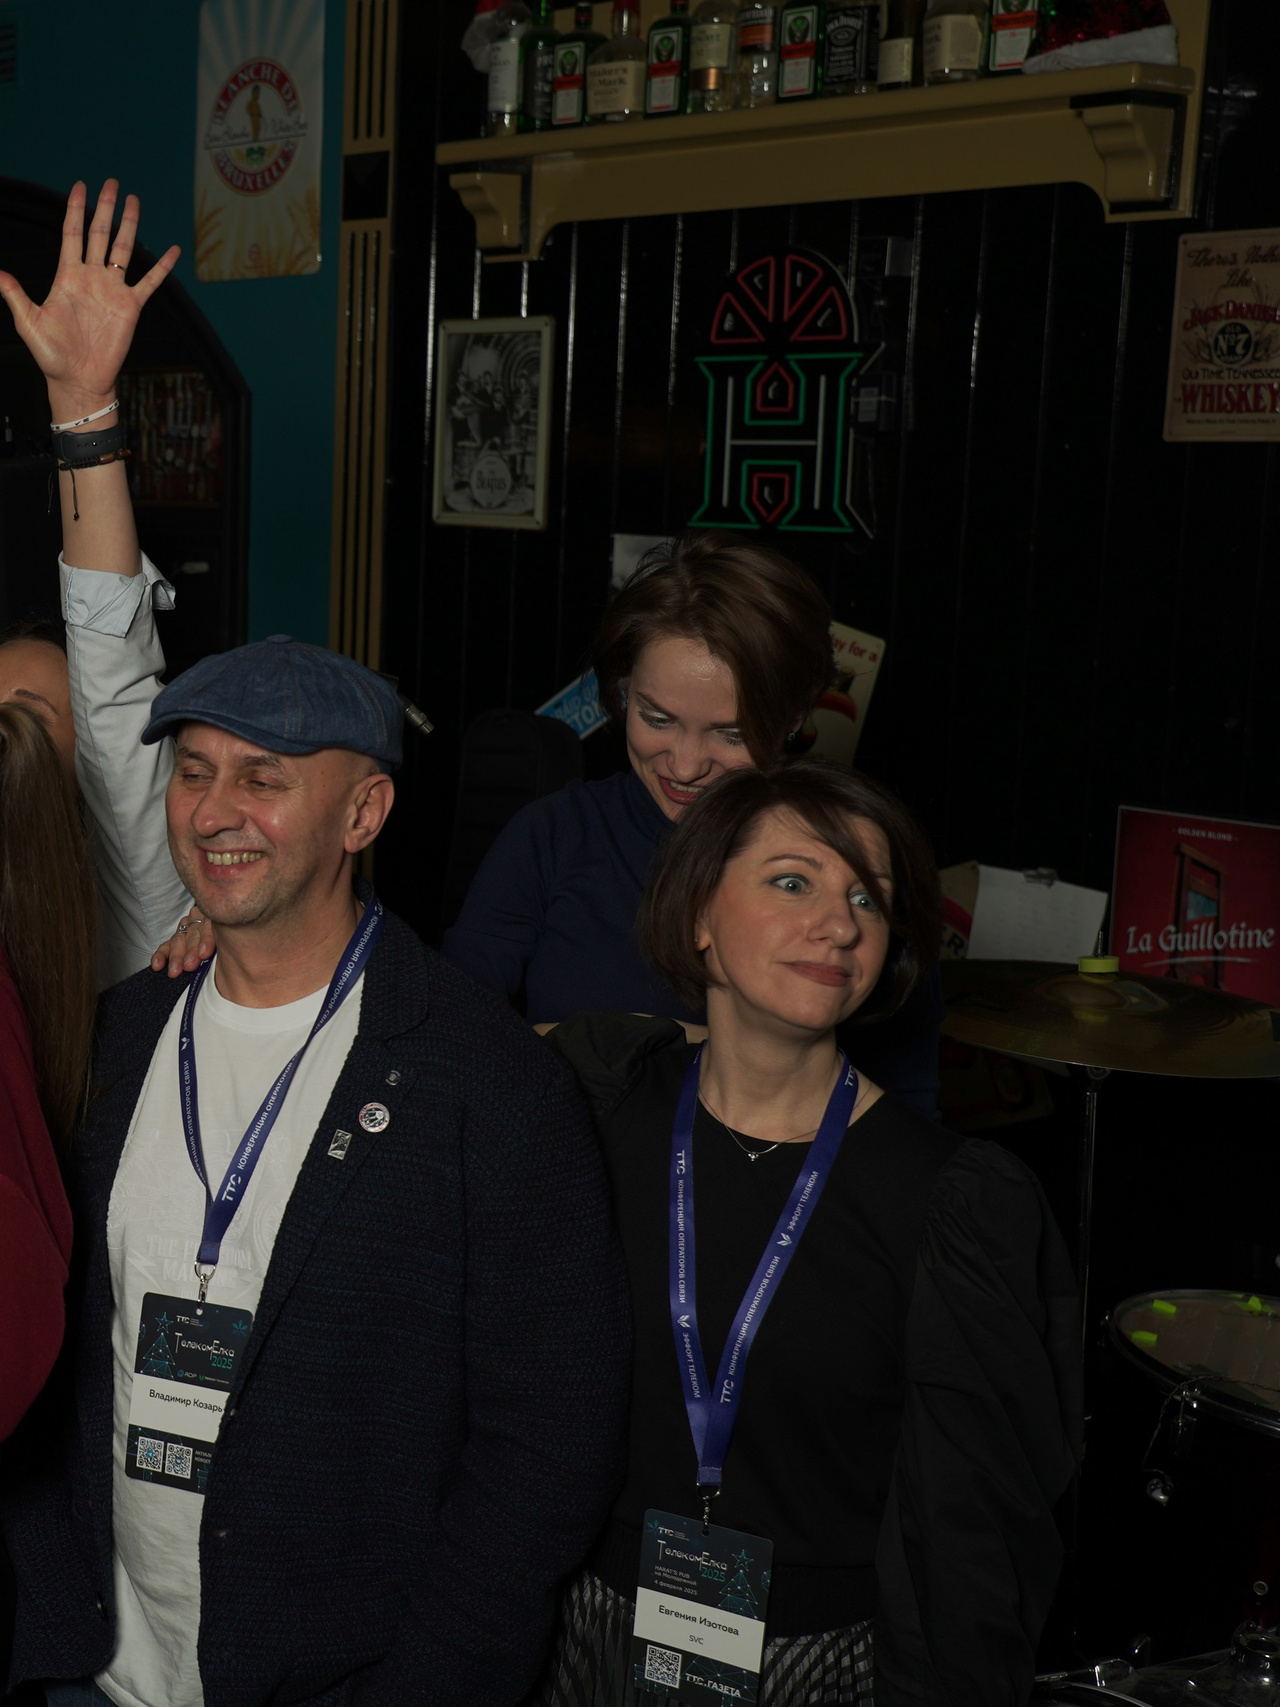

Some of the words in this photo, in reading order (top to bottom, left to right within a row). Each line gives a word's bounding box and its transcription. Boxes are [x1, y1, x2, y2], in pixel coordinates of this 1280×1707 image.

[1183, 304, 1224, 331] JACK
[1202, 368, 1224, 381] TIME
[1181, 382, 1280, 414] WHISKEY
[476, 469, 506, 493] BEATLES
[849, 641, 867, 659] for
[868, 652, 878, 663] a
[1177, 827, 1206, 838] GOLDEN
[1207, 831, 1233, 842] BLOND
[351, 915, 379, 962] КОНФЕРЕНЦИЯ
[1126, 925, 1153, 954] La
[1158, 922, 1276, 955] Guillotine
[328, 961, 355, 1009] ОПЕРАТОРОВ
[183, 1060, 191, 1085] СВЯЗИ
[185, 1086, 194, 1135] ОПЕРАТОРОВ
[237, 1111, 269, 1170] КОНФЕРЕНЦИЯ
[677, 1179, 685, 1232] КОНФЕРЕНЦИЯ
[678, 1232, 686, 1277] ОПЕРАТОРОВ
[728, 1322, 749, 1376] КОНФЕРЕНЦИЯ
[744, 1277, 769, 1322] ОПЕРАТОРОВ
[765, 1255, 780, 1278] СВЯЗИ
[787, 1202, 805, 1232] ЭФФОРТ
[799, 1170, 819, 1203] ТЕЛЕКОМ
[678, 1278, 686, 1303] СВЯЗИ
[682, 1332, 694, 1363] ЭФФОРТ
[211, 1356, 233, 1370] 2025
[686, 1363, 701, 1399] ТЕЛЕКОМ
[149, 1389, 192, 1407] Владимир
[193, 1398, 223, 1413] Козарь
[655, 1565, 678, 1575] HARAT'S
[679, 1571, 690, 1579] PUB
[701, 1566, 726, 1583] 2025
[659, 1580, 683, 1591] февраля
[683, 1587, 698, 1596] 2025
[658, 1605, 697, 1623] Евгения
[699, 1616, 739, 1636] Изотова
[689, 1634, 704, 1645] SVC
